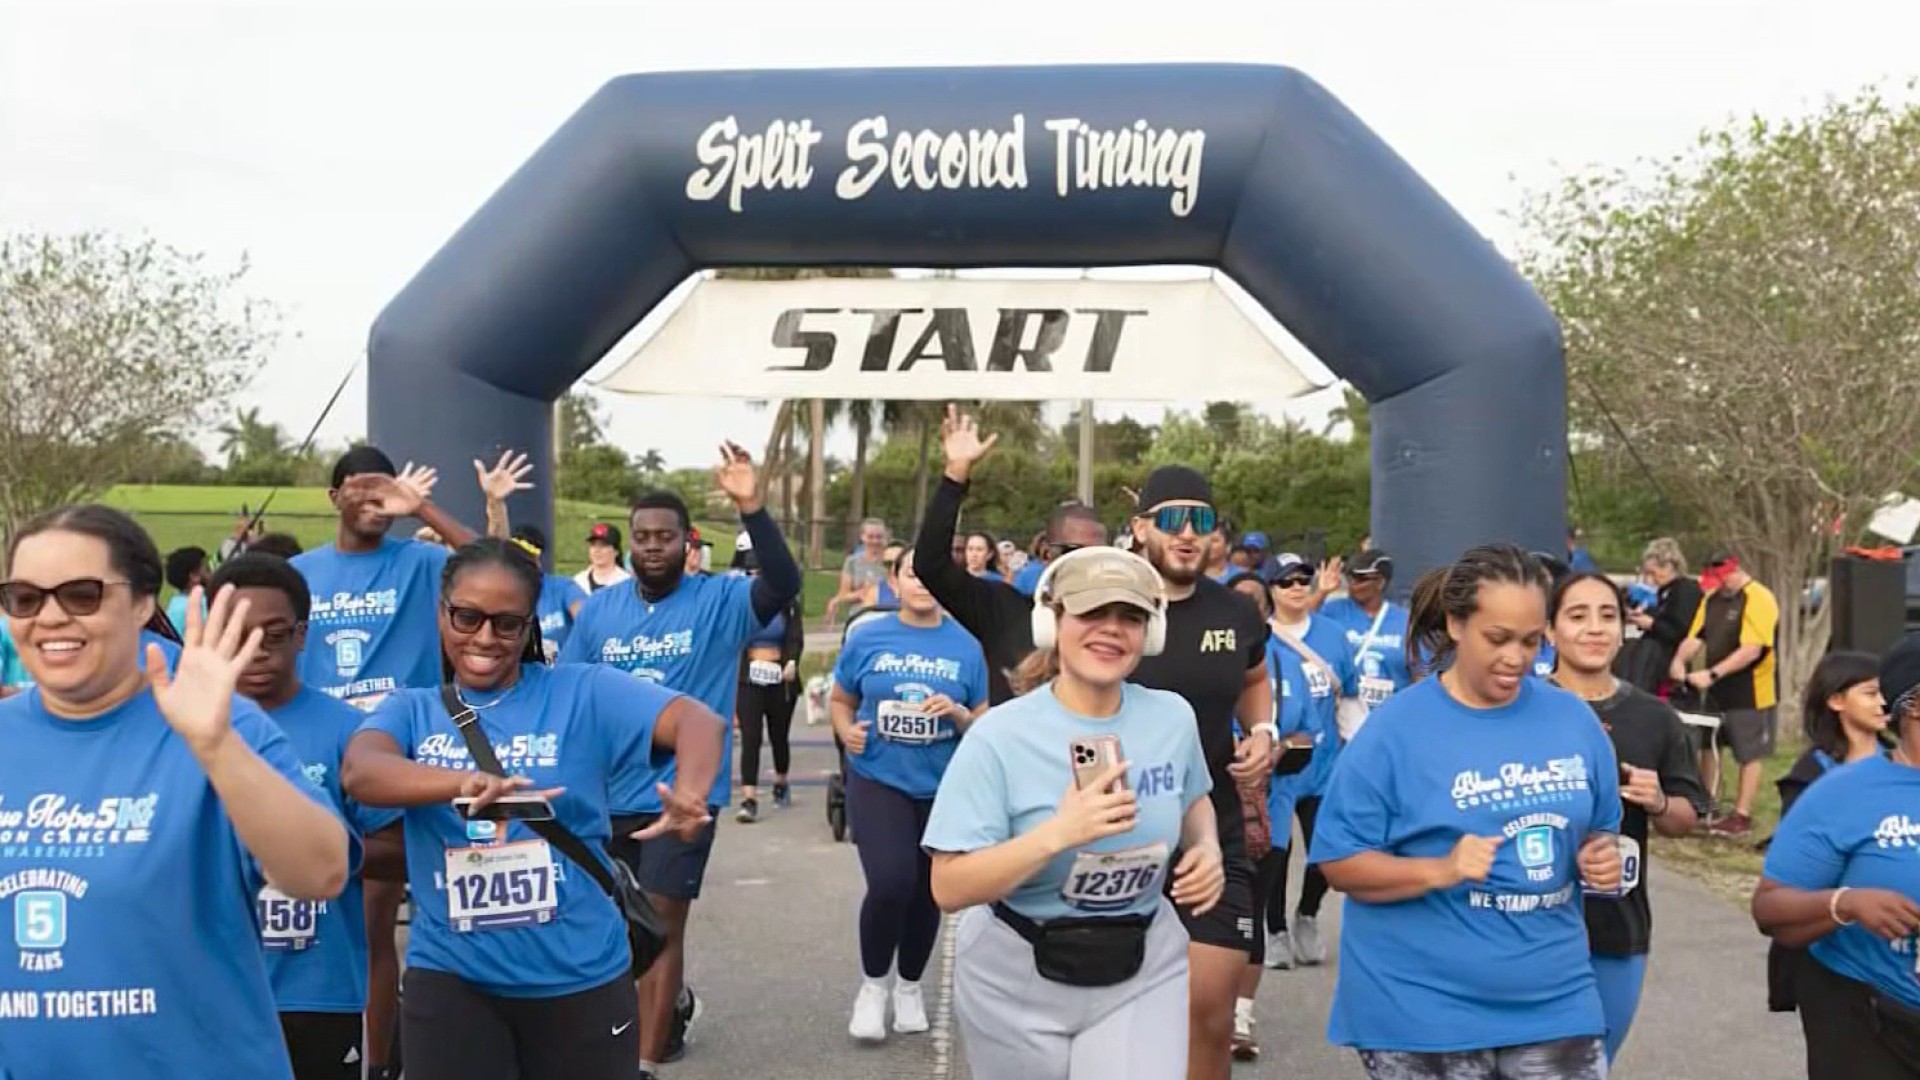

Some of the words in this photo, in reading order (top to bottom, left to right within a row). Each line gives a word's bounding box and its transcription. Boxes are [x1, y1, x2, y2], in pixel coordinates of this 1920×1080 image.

[686, 115, 822, 212] Split
[835, 113, 1027, 200] Second
[1044, 118, 1205, 217] Timing
[765, 307, 1149, 372] START
[1200, 628, 1236, 652] AFG
[881, 714, 935, 735] 12551
[1137, 762, 1174, 796] AFG
[1525, 832, 1545, 861] 5
[452, 866, 549, 910] 12457
[1072, 864, 1159, 897] 12376
[1469, 889, 1492, 908] WE
[26, 900, 54, 941] 5
[43, 988, 157, 1019] TOGETHER
